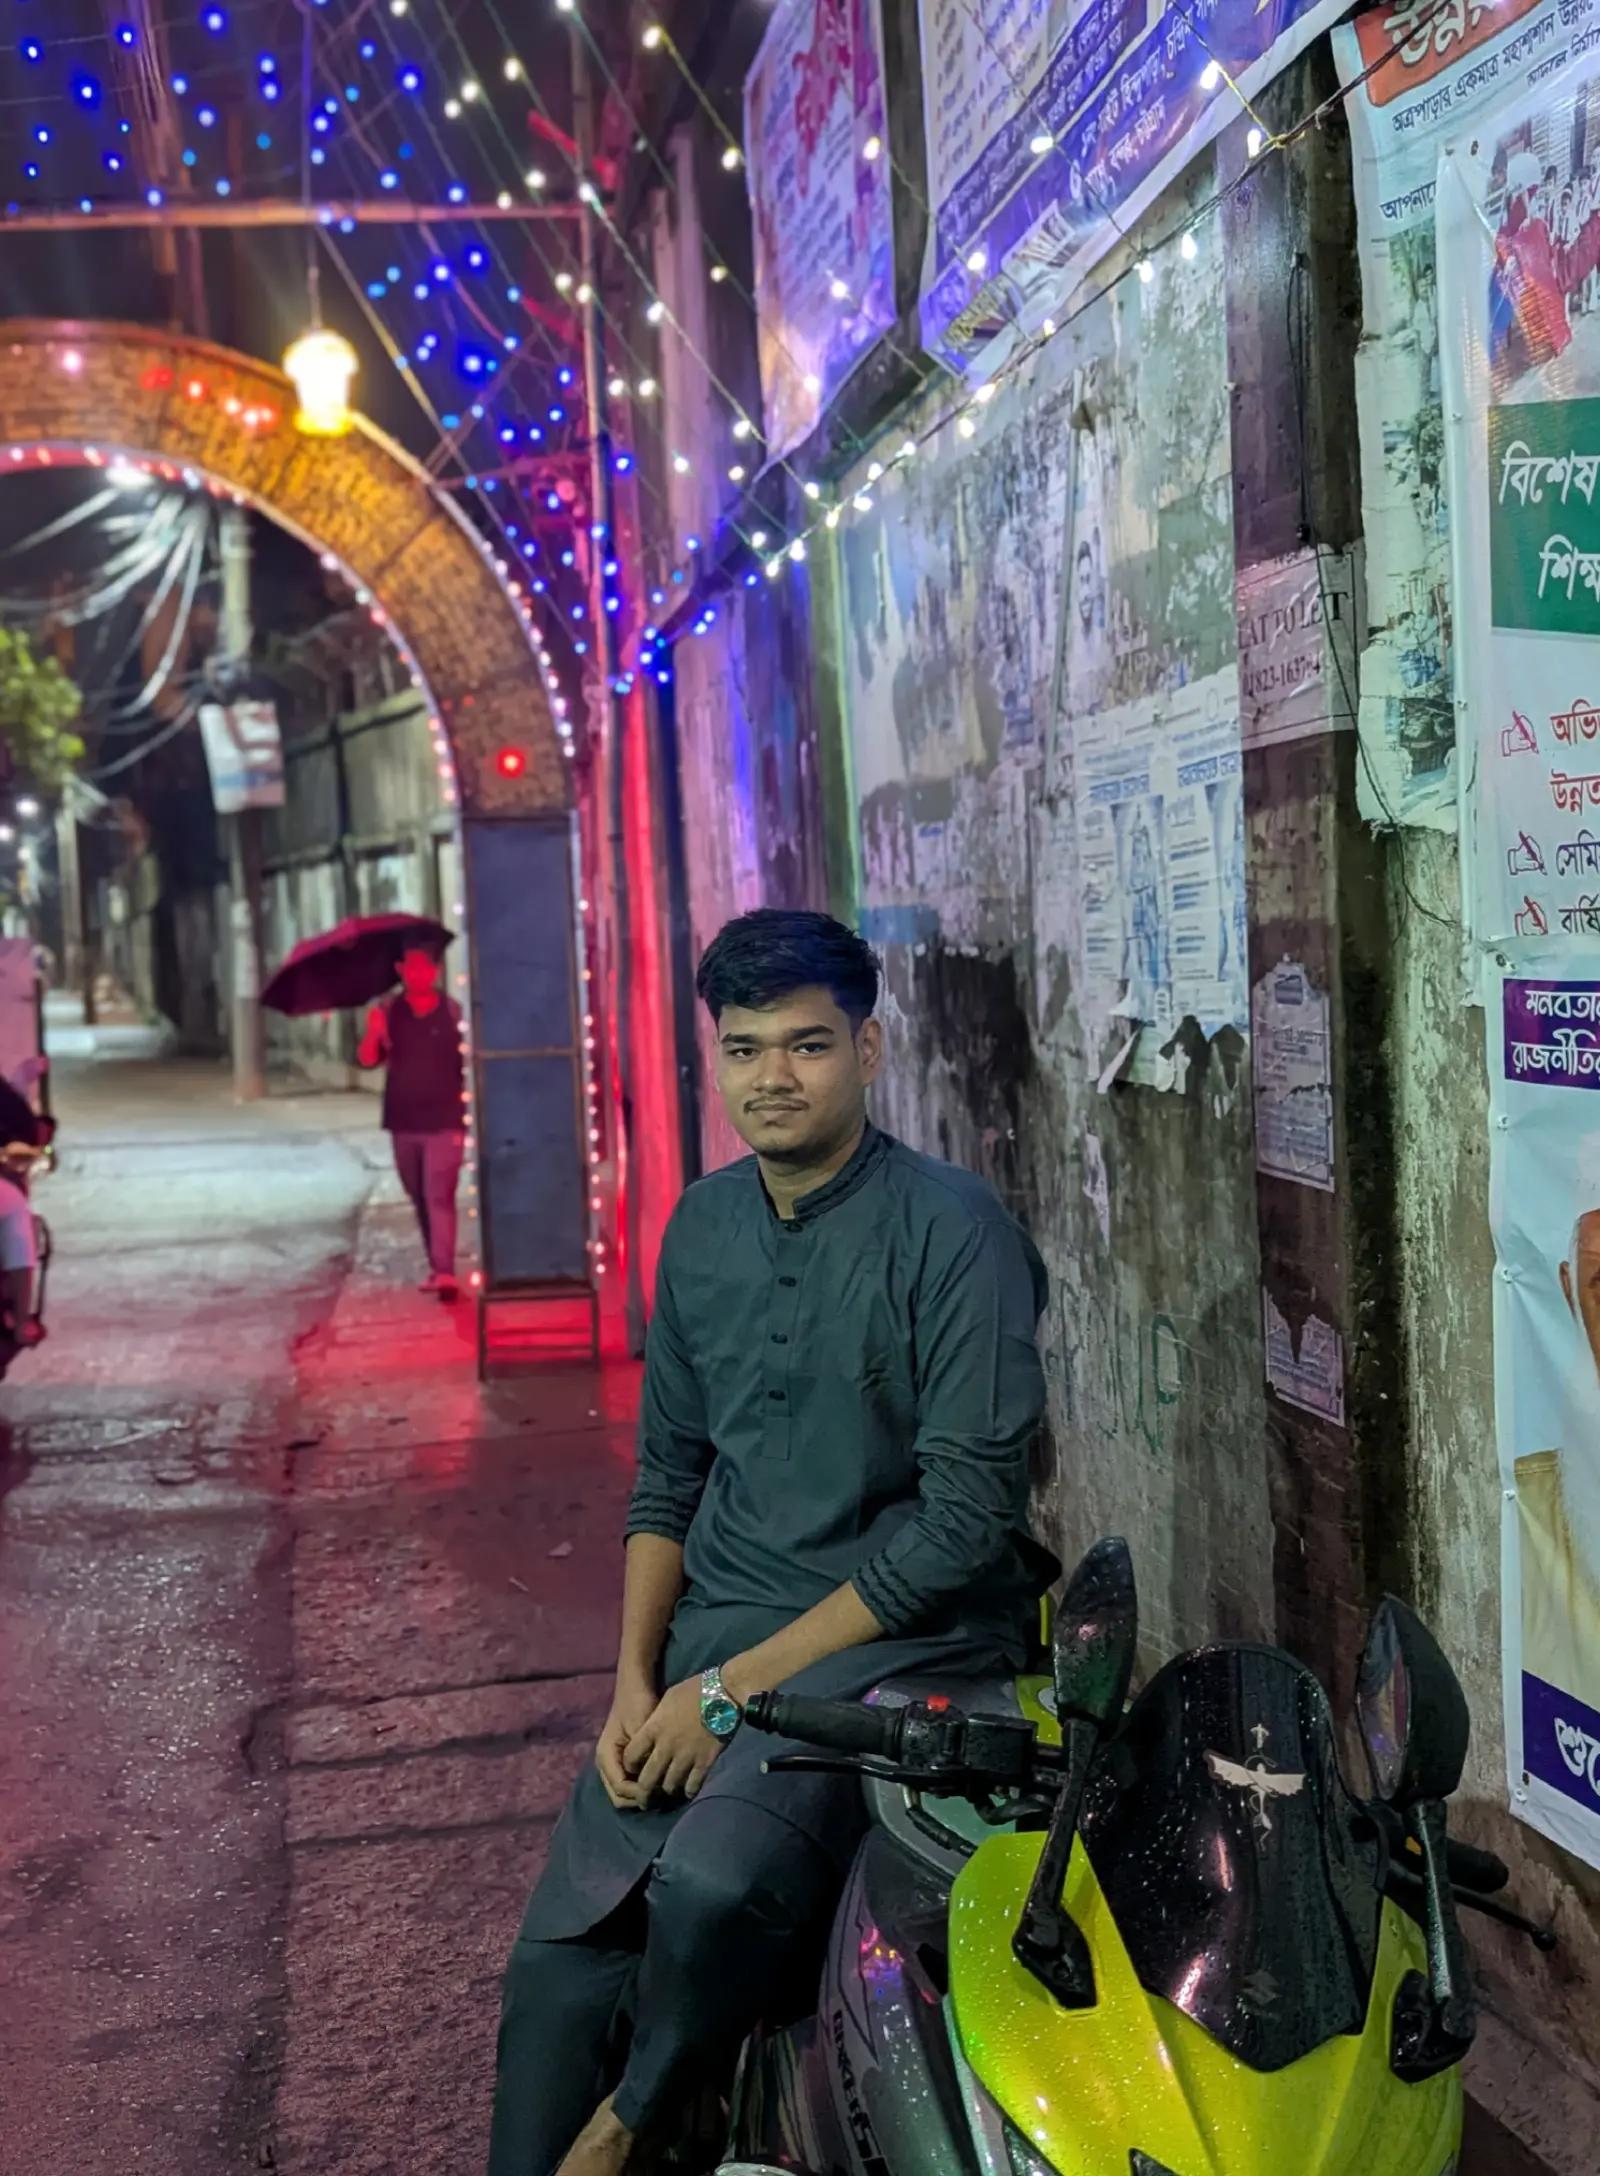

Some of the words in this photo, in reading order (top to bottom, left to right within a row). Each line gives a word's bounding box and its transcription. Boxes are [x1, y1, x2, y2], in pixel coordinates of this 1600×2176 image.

[1455, 53, 1500, 97] একমাত্র
[1550, 698, 1600, 746] অভি
[1524, 990, 1600, 1026] মনবতা
[1510, 1027, 1600, 1082] রাজনীতি
